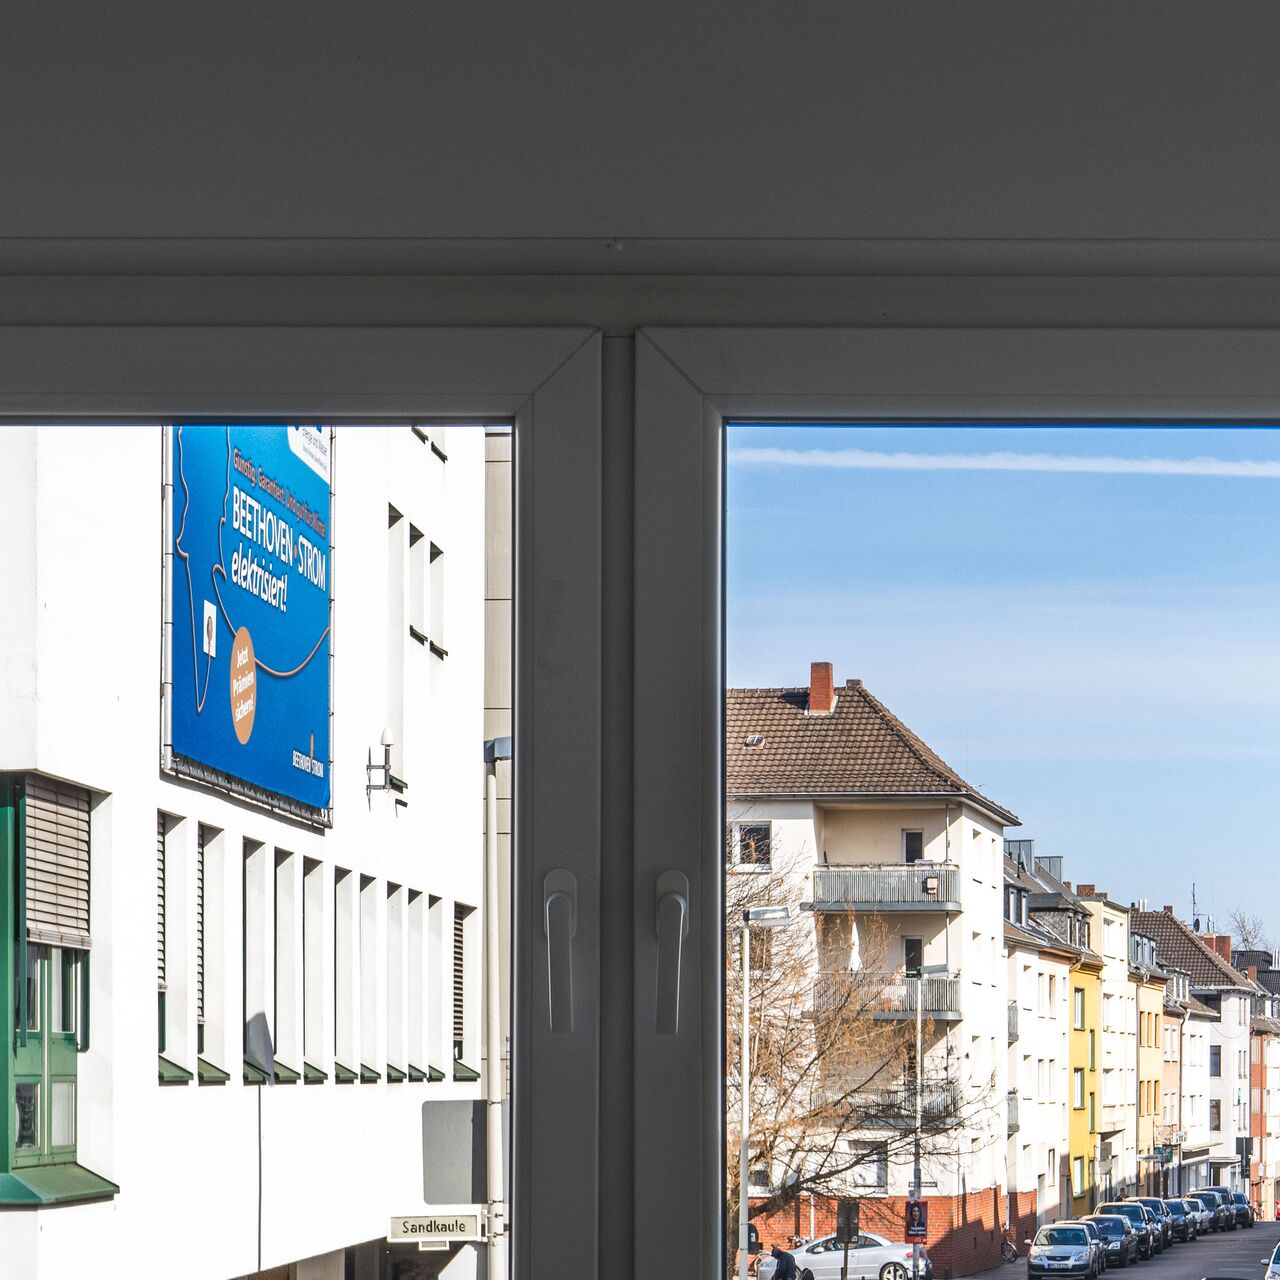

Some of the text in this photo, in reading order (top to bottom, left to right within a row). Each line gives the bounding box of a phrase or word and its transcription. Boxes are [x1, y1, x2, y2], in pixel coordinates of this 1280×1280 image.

[232, 485, 326, 591] BEETHOVEN STROM
[231, 542, 288, 613] elektrisiert!
[292, 749, 324, 778] BEETHOVEN STROM
[402, 1219, 466, 1234] Sandkaule
